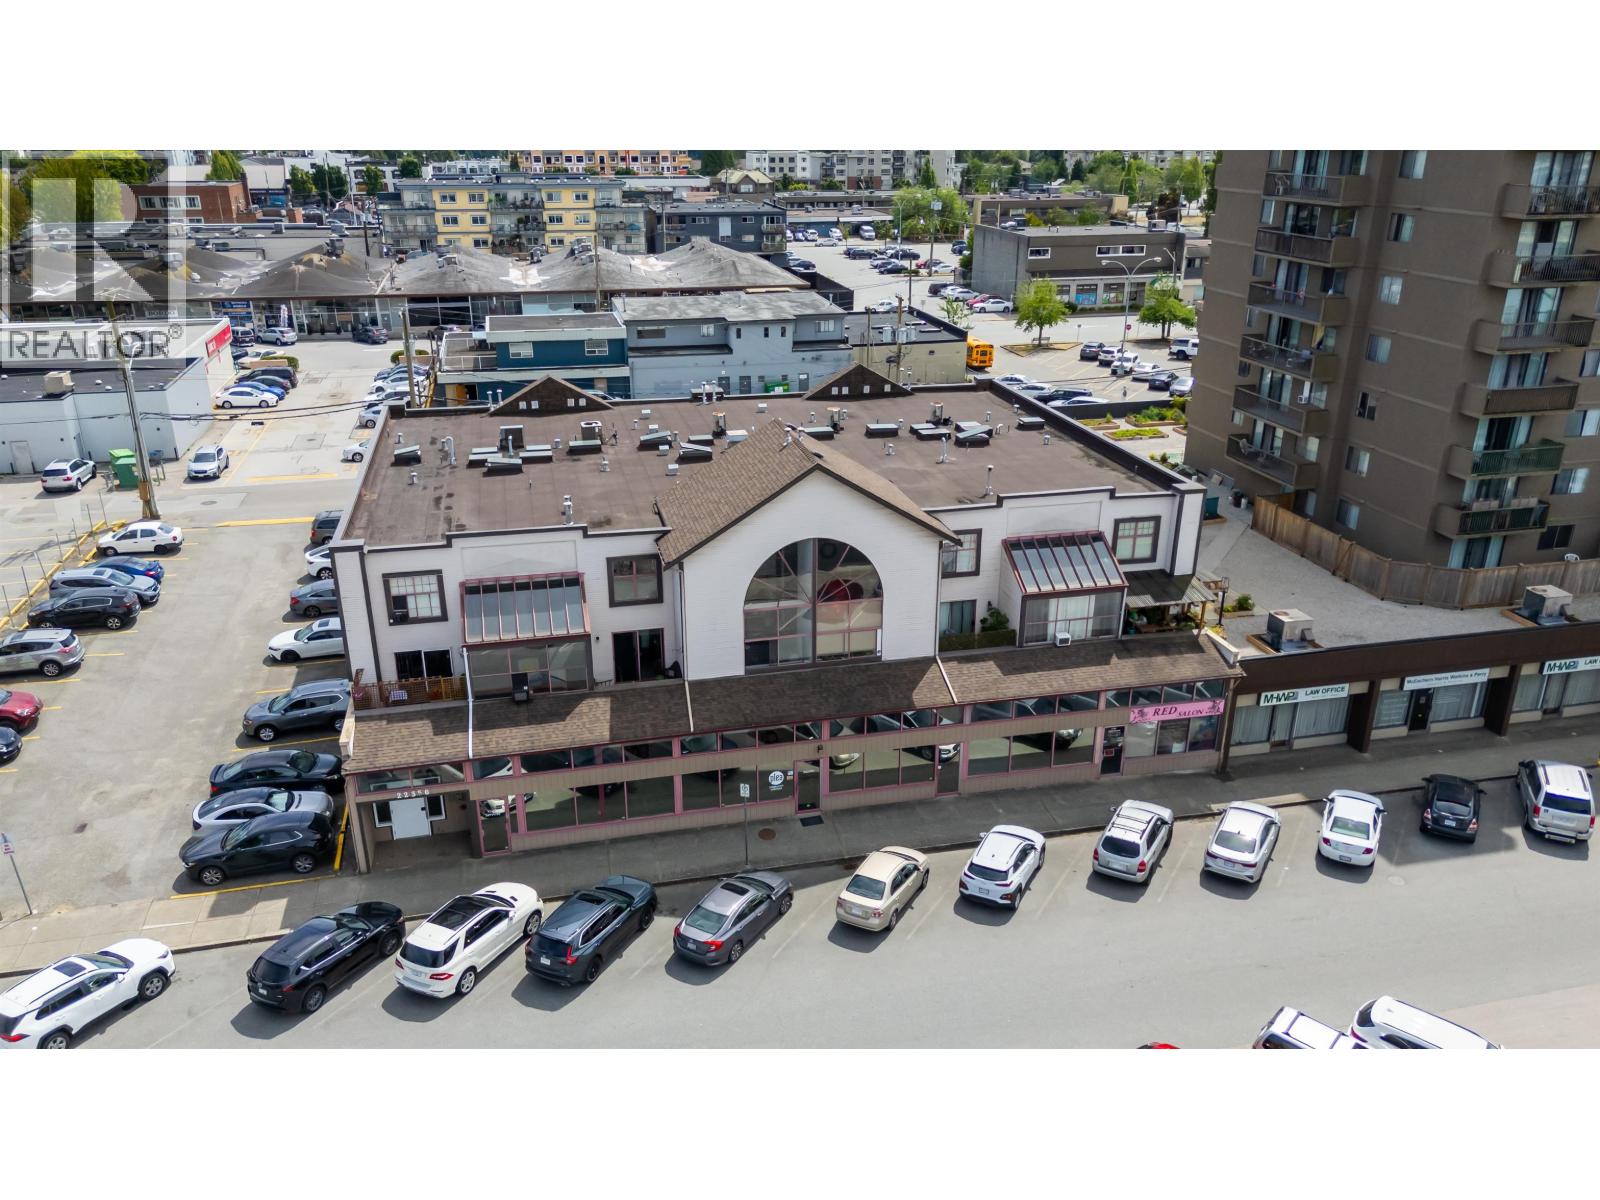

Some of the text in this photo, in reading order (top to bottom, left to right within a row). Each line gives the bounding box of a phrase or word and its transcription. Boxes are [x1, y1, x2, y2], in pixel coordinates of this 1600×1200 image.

[1321, 686, 1346, 694] OFFICE
[1152, 706, 1178, 717] RED
[1178, 709, 1204, 717] SALON
